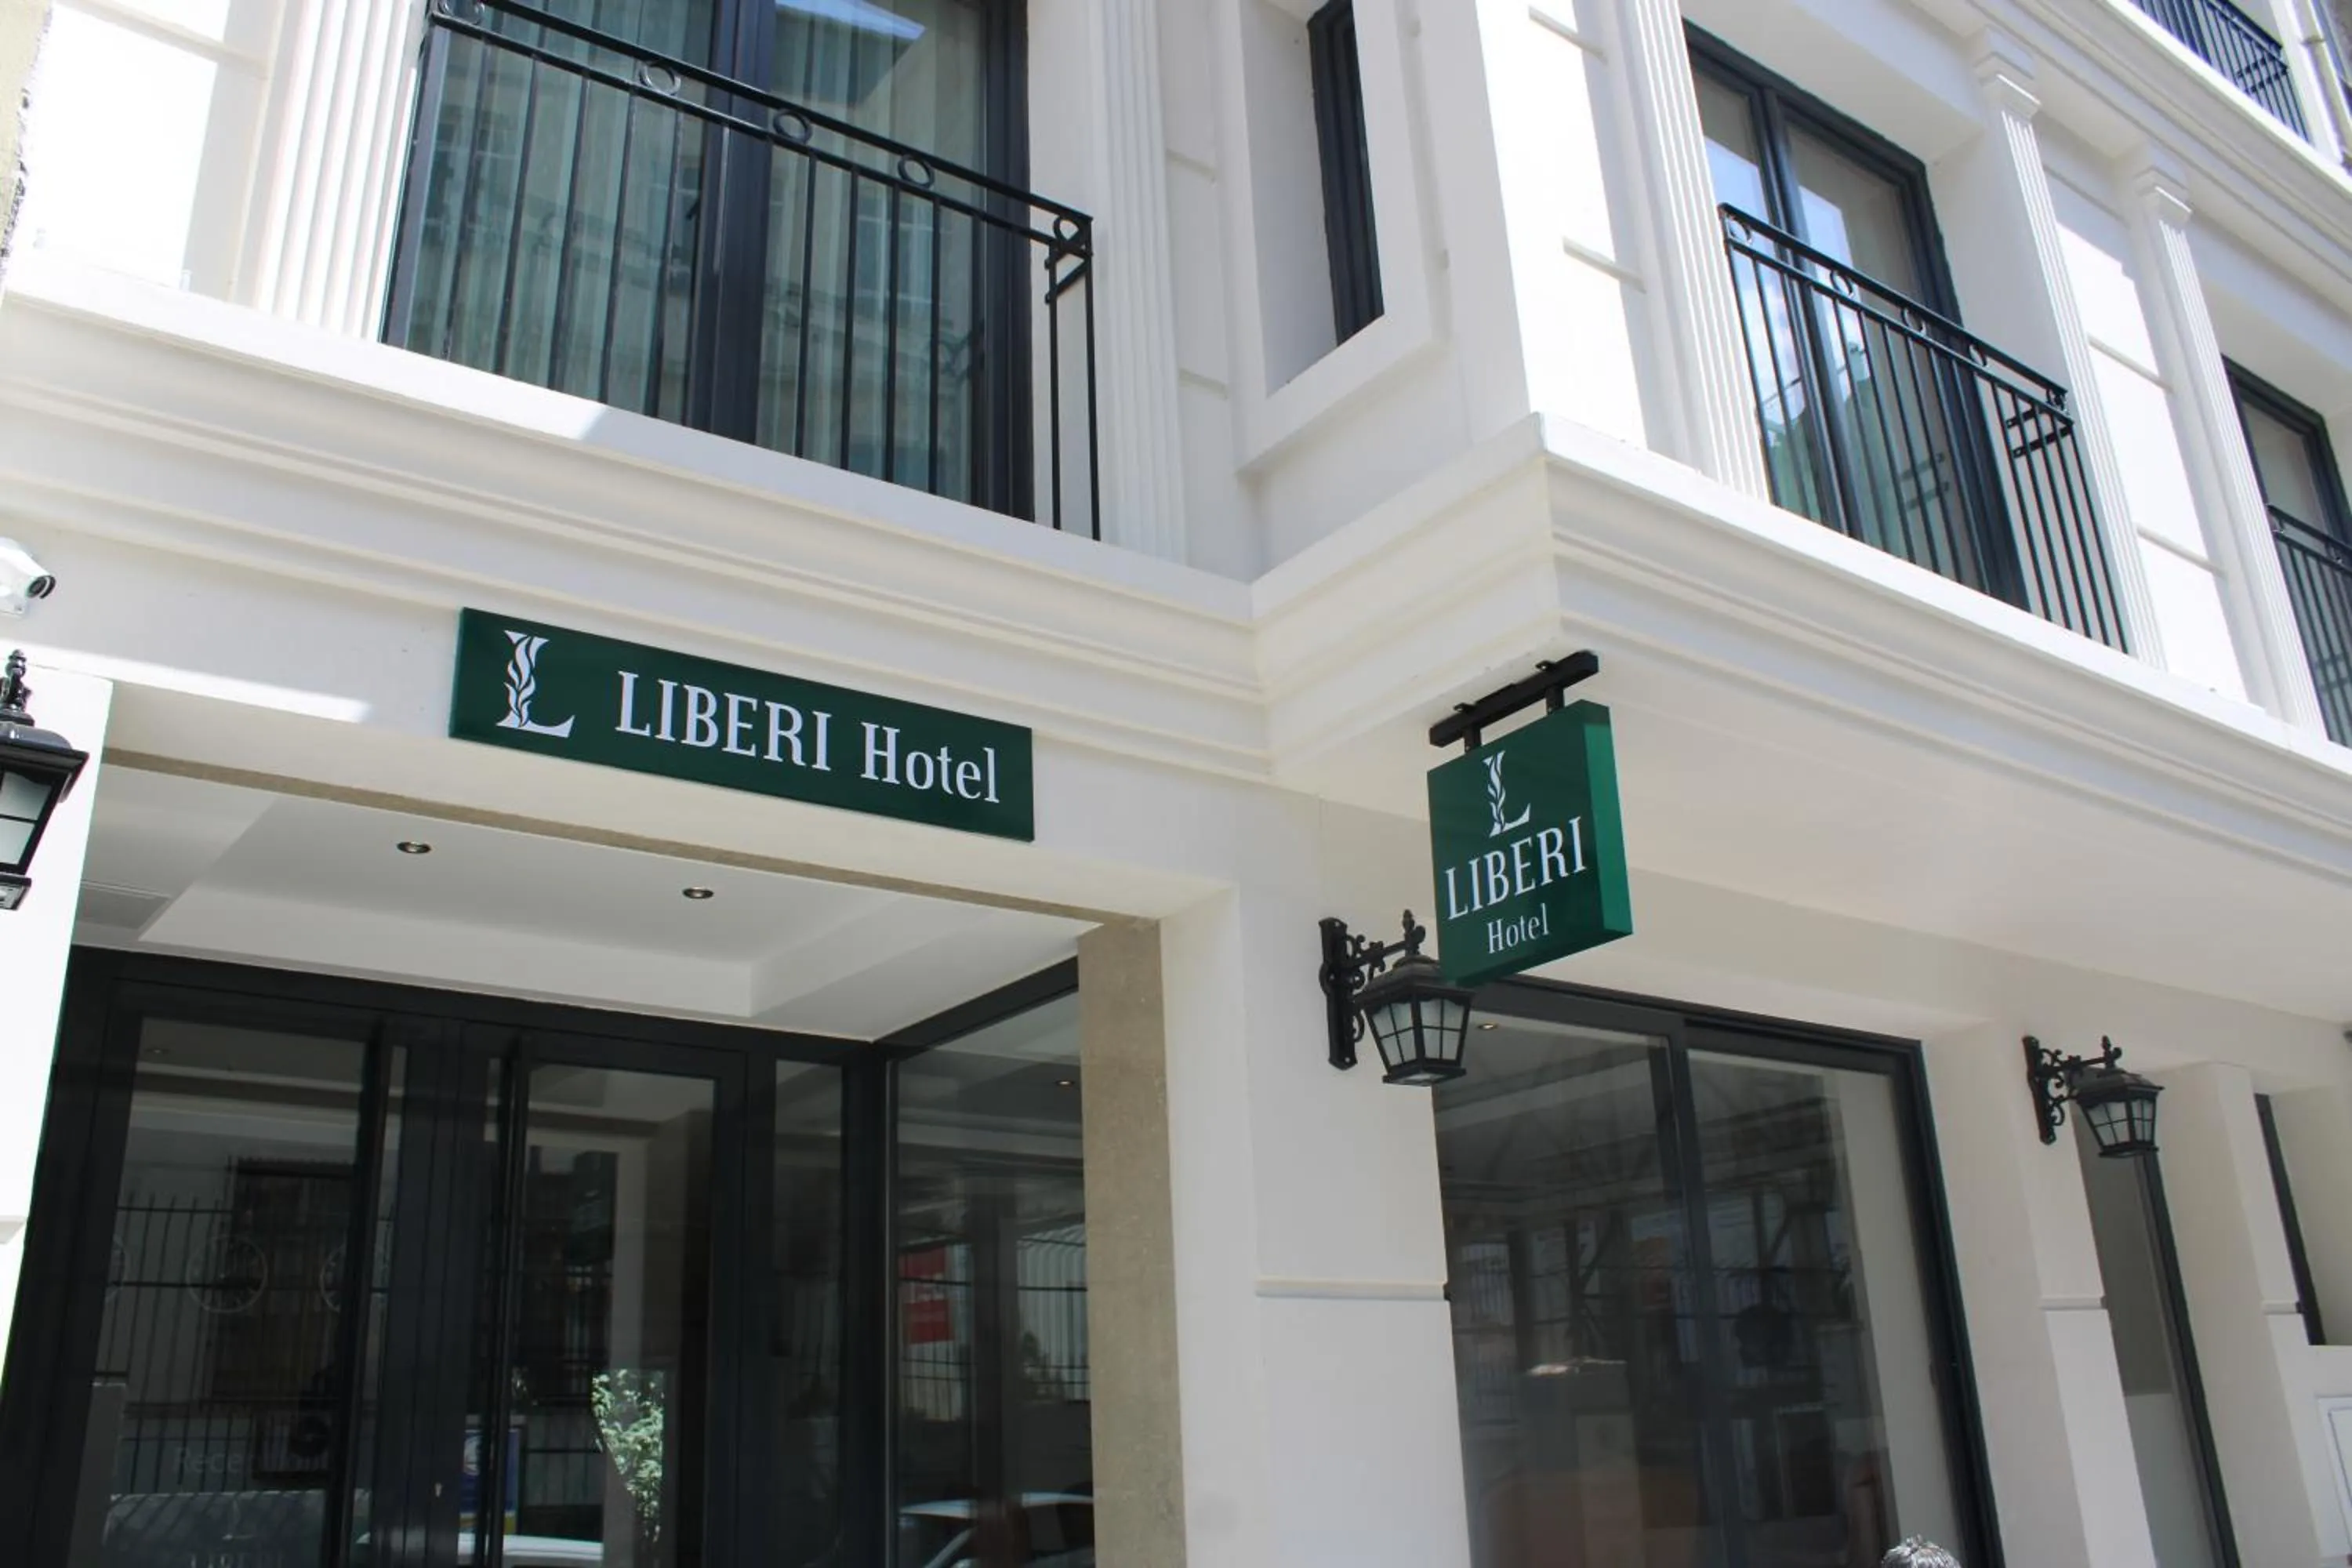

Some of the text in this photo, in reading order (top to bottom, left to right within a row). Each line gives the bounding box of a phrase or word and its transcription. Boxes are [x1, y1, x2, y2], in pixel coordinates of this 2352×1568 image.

[615, 670, 833, 771] LIBERI
[860, 721, 1000, 804] Hotel
[1444, 816, 1587, 920] LIBERI
[1487, 902, 1550, 954] Hotel
